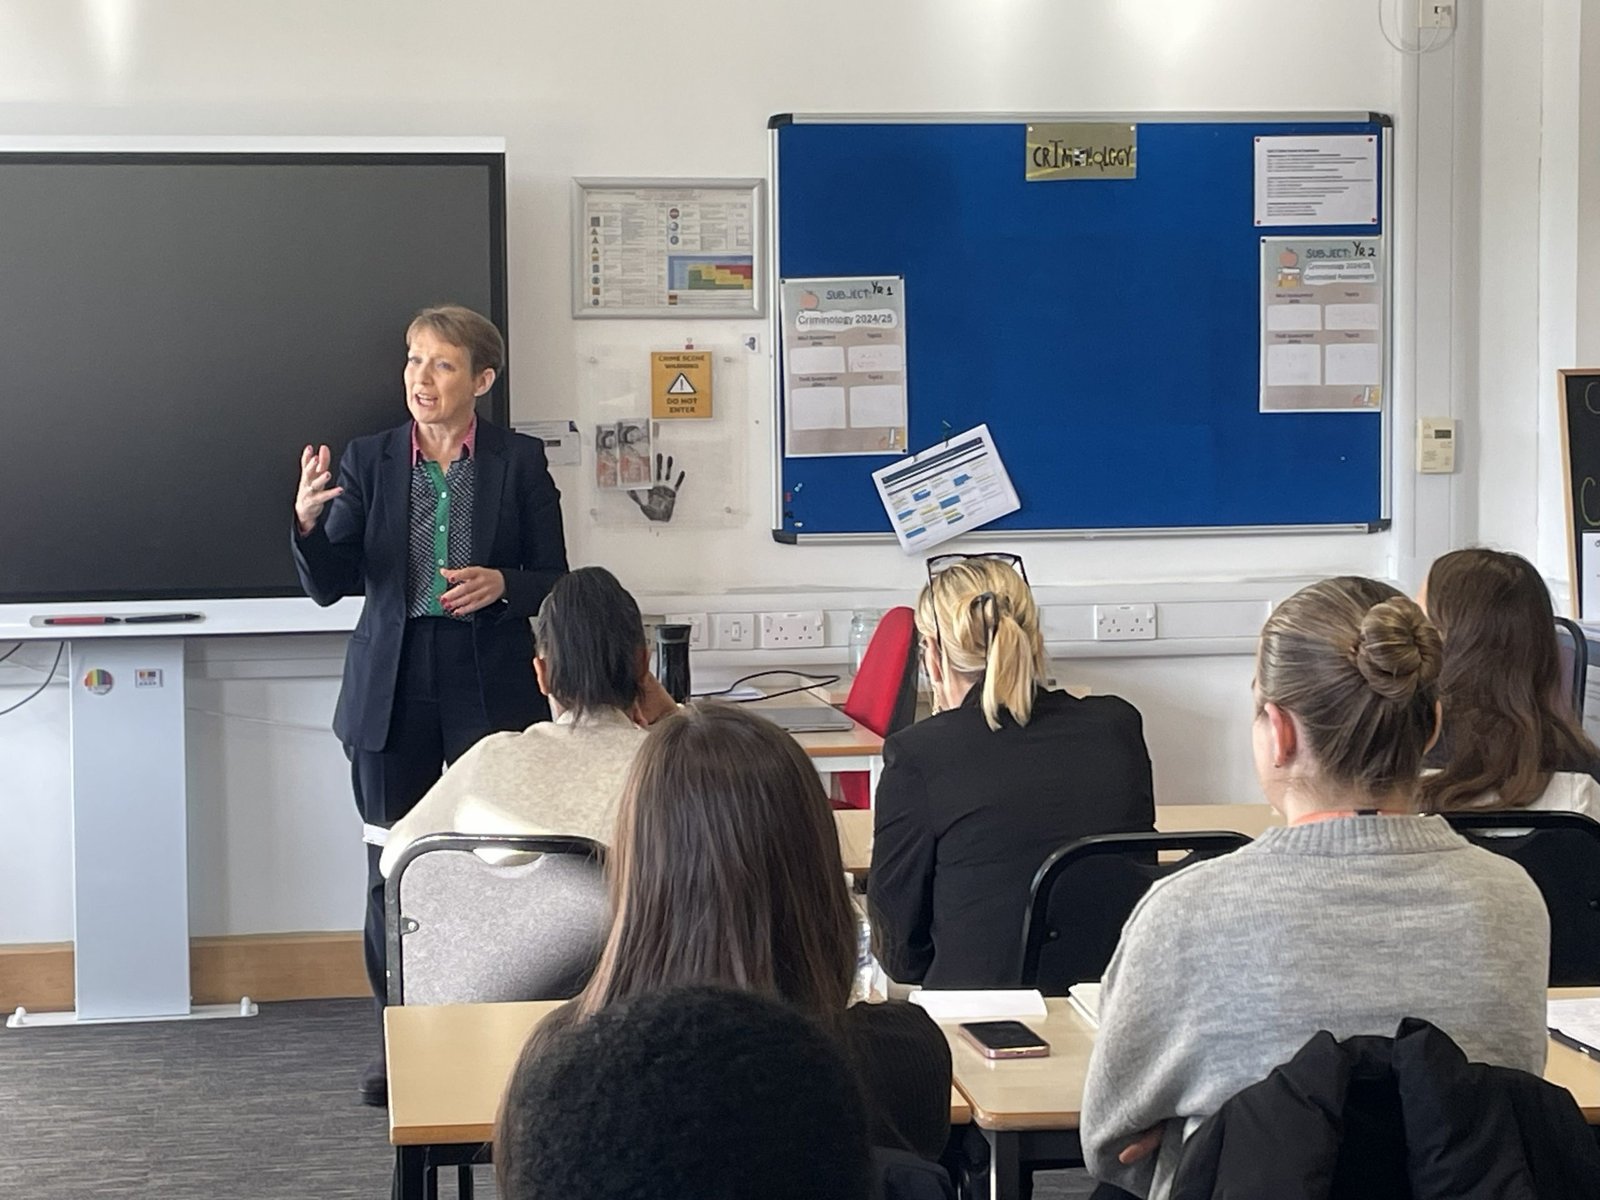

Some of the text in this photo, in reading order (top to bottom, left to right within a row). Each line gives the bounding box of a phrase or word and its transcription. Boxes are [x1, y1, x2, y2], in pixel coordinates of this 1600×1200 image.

[1367, 247, 1376, 257] 2
[886, 286, 893, 295] 1
[798, 314, 893, 325] Criminology 2024/25
